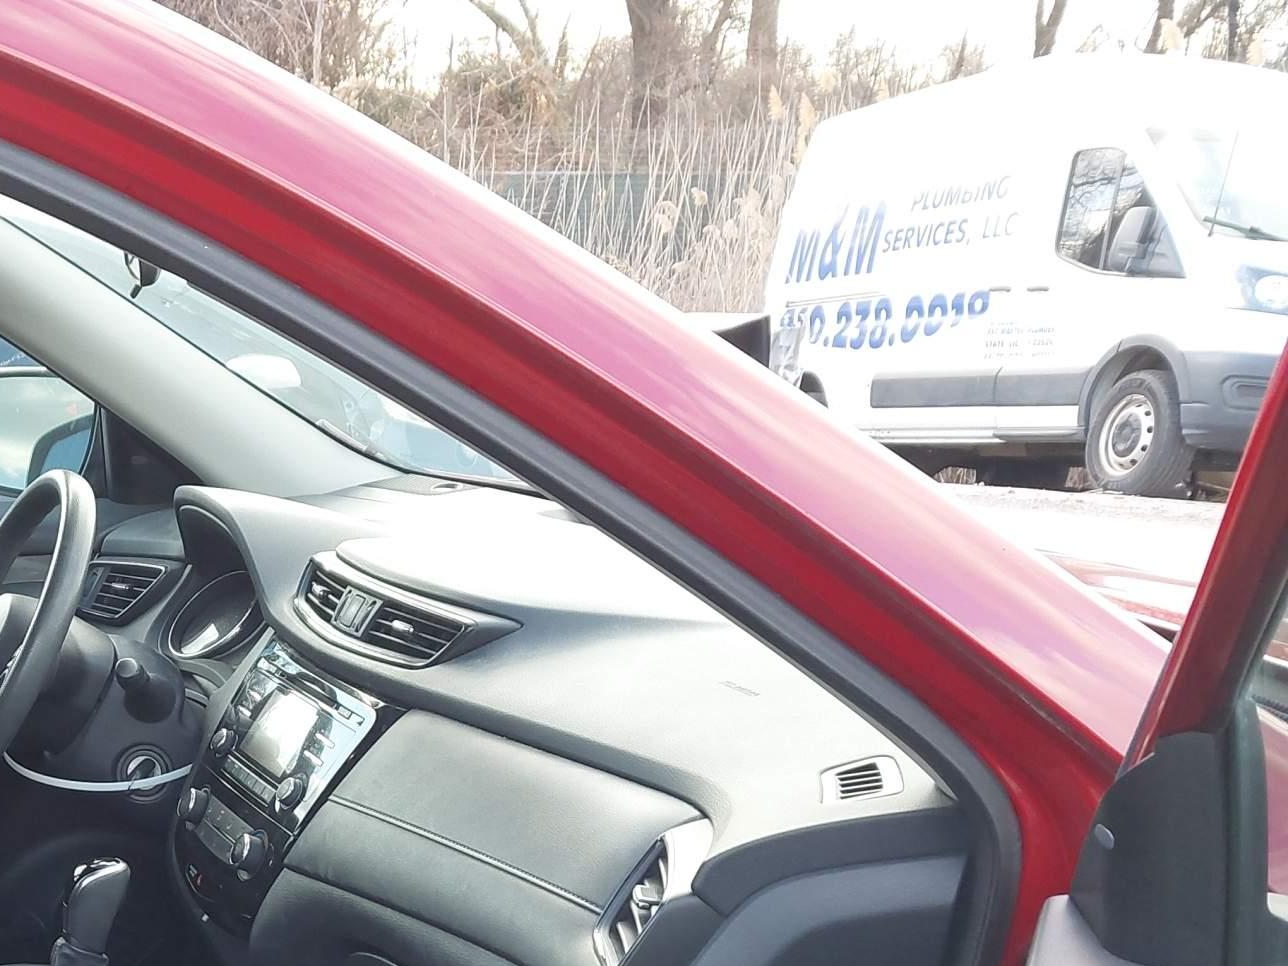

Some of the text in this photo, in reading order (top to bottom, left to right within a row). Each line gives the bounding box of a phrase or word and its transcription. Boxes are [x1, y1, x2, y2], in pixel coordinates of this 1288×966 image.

[911, 175, 1011, 212] PLUMBING
[785, 200, 887, 285] M&M
[881, 212, 1019, 253] SERVICES, LLC
